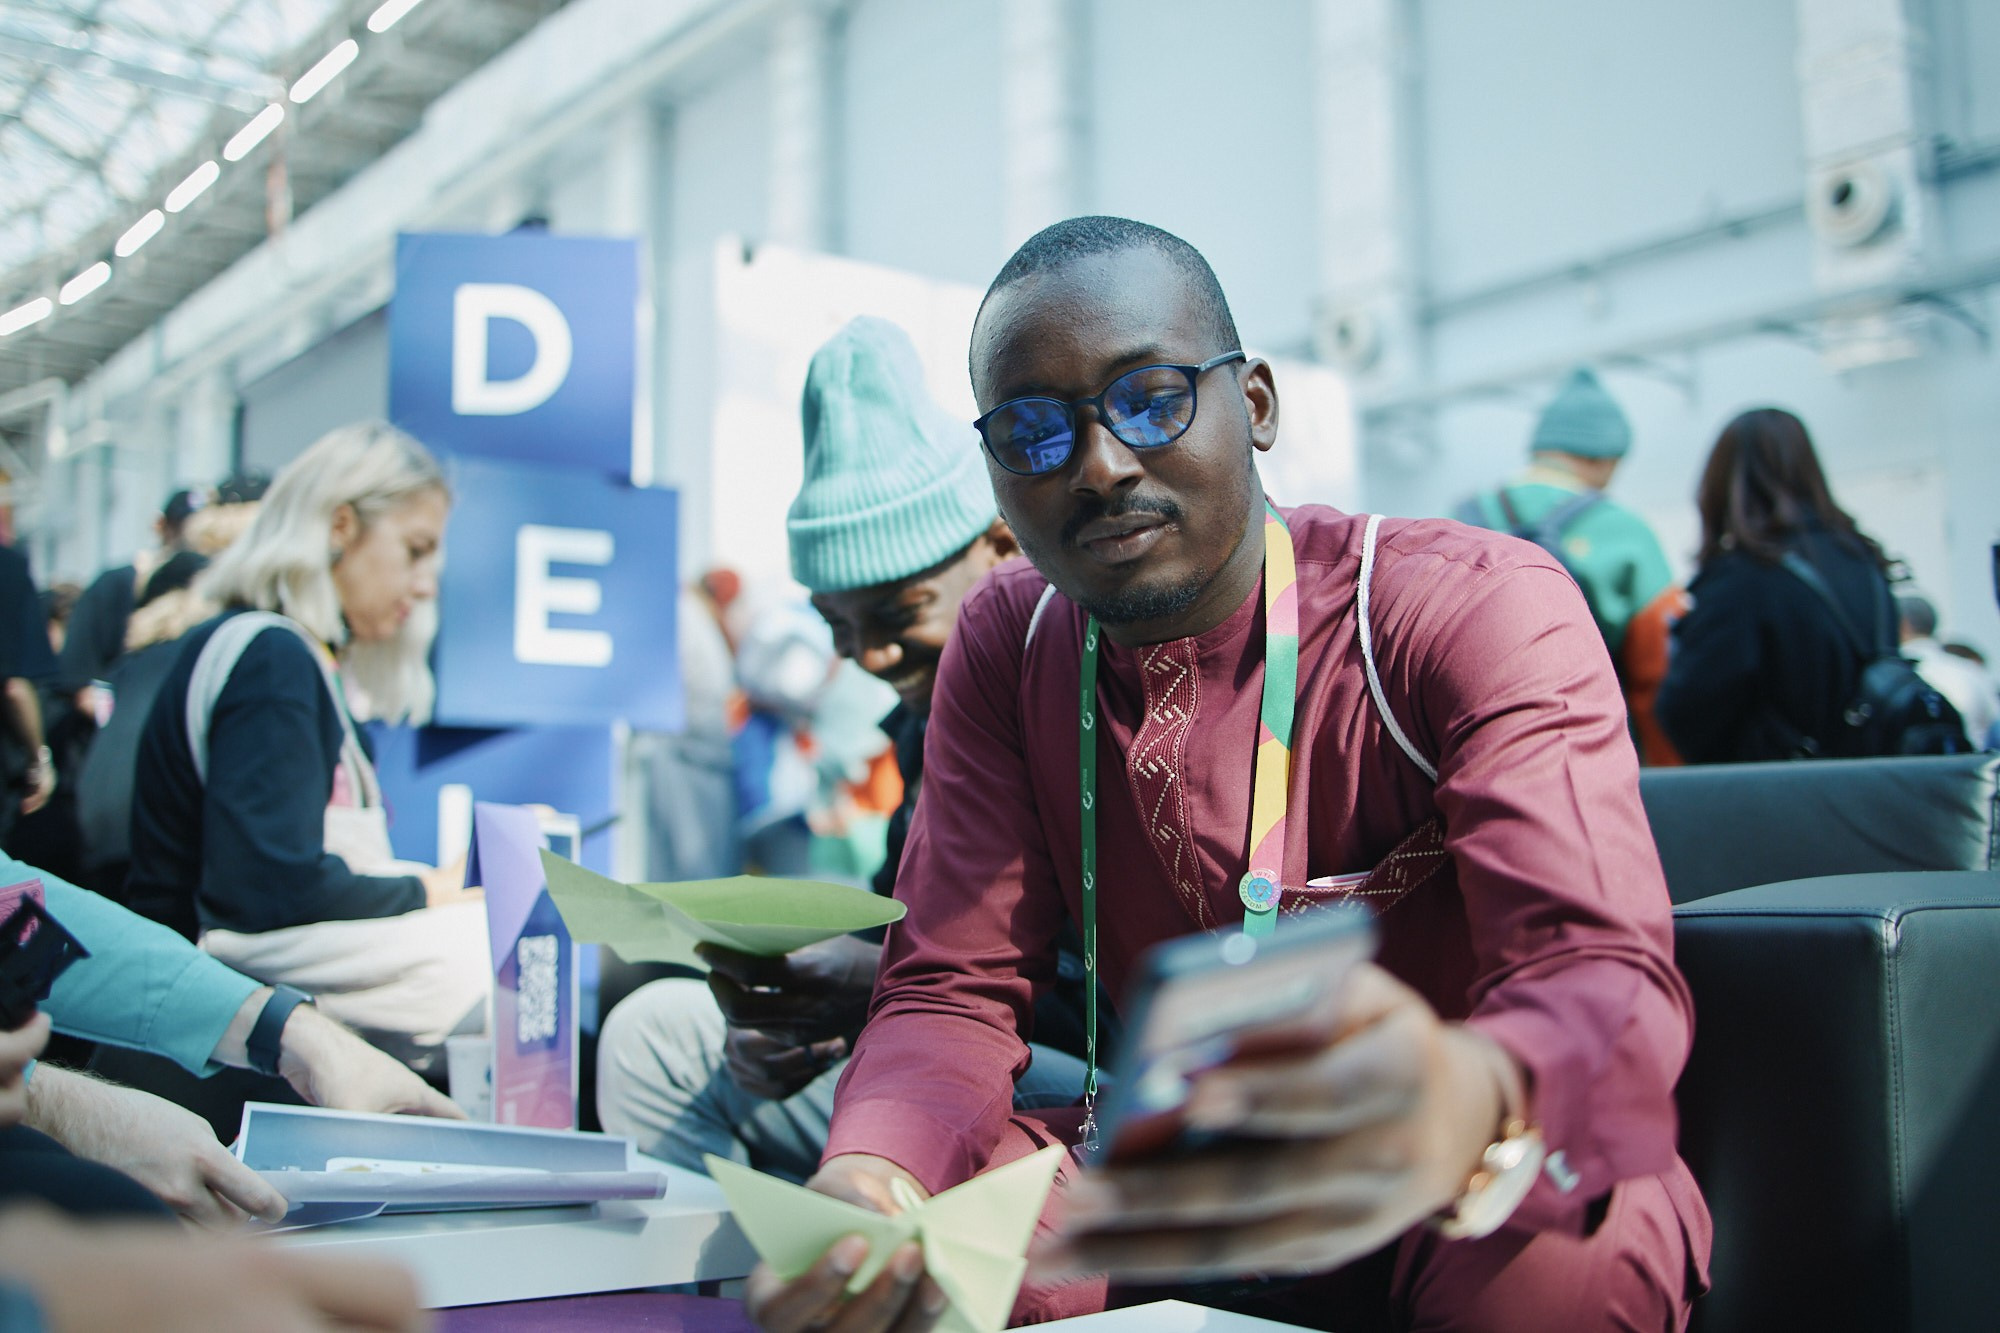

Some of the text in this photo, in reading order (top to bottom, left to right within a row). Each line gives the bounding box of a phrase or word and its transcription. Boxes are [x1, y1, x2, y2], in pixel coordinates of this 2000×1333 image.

[452, 282, 573, 416] D
[514, 524, 614, 667] E
[1241, 879, 1262, 909] ROSATOM
